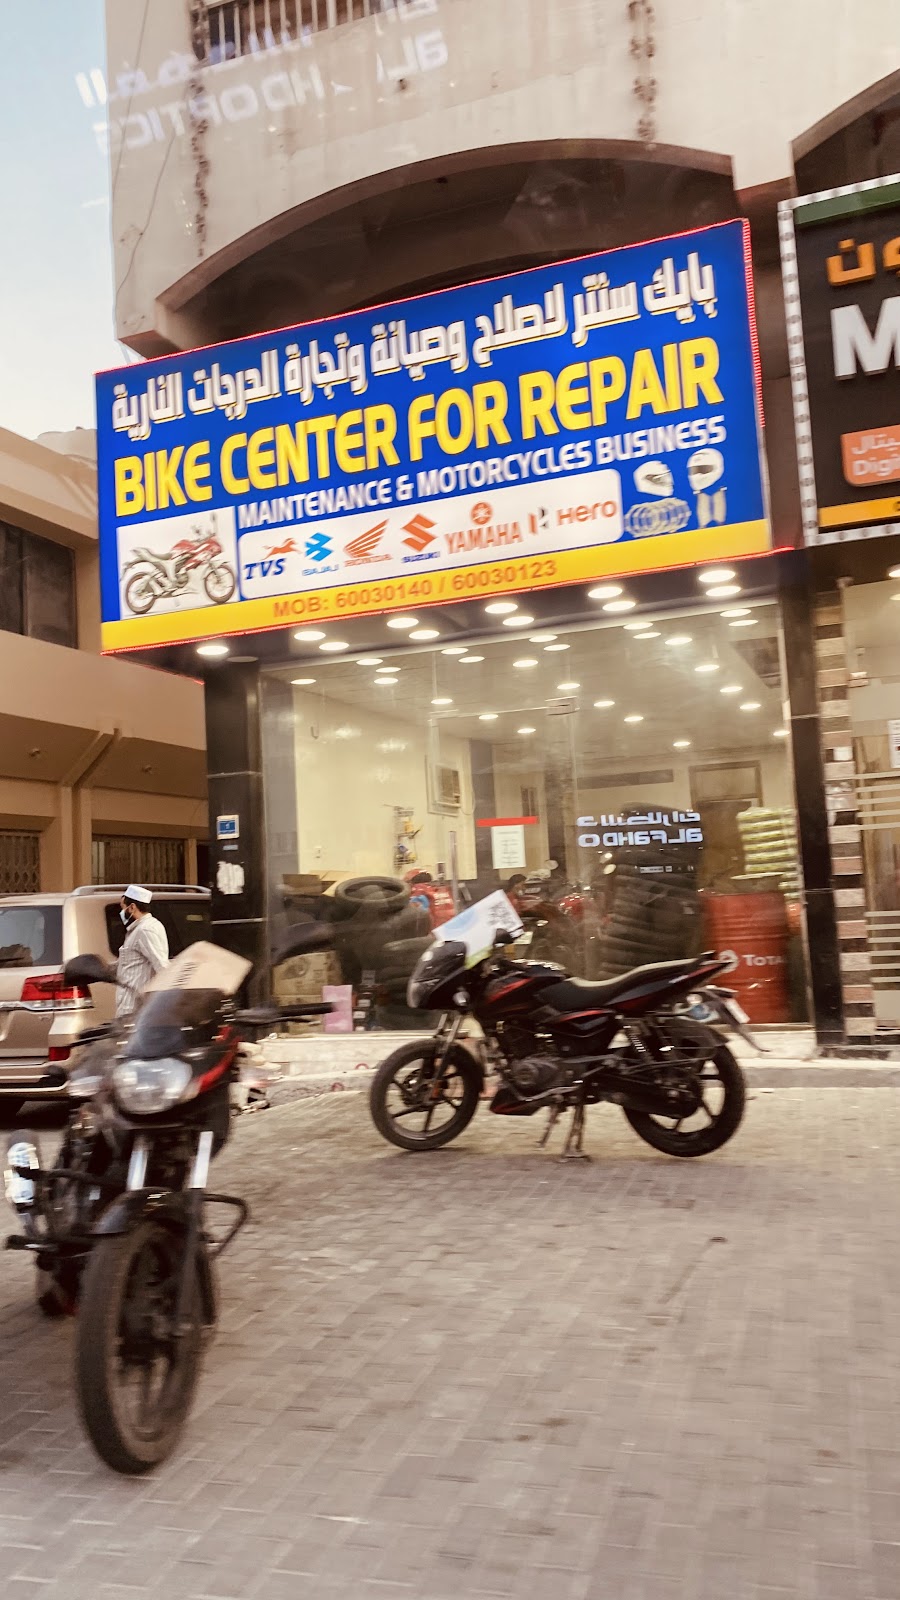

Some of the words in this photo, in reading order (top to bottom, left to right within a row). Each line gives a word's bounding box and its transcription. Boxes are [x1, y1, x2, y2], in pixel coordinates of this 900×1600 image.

[571, 271, 641, 348] سنتر
[643, 252, 718, 324] بايك
[283, 332, 369, 407] وتجارة
[370, 318, 469, 382] وصيانة
[111, 371, 186, 441] النارية
[114, 440, 213, 517] BIKE
[220, 403, 401, 495] CENTER
[408, 380, 512, 462] FOR
[518, 336, 725, 440] REPAIR
[237, 477, 393, 529] MAINTENANCE
[396, 474, 414, 501] &
[417, 440, 593, 497] MOTORCYCLES
[596, 415, 727, 465] BUSINESS
[444, 520, 523, 555] YAMAHA
[555, 499, 617, 527] Hero
[244, 558, 287, 580] TVS
[301, 564, 340, 577] BAJAJ
[344, 552, 393, 568] HONDA
[400, 551, 441, 564] SUZUKI
[273, 595, 330, 618] MOB:
[335, 578, 433, 608] 60030140
[451, 560, 557, 591] 60030123
[742, 953, 787, 967] TOTA
